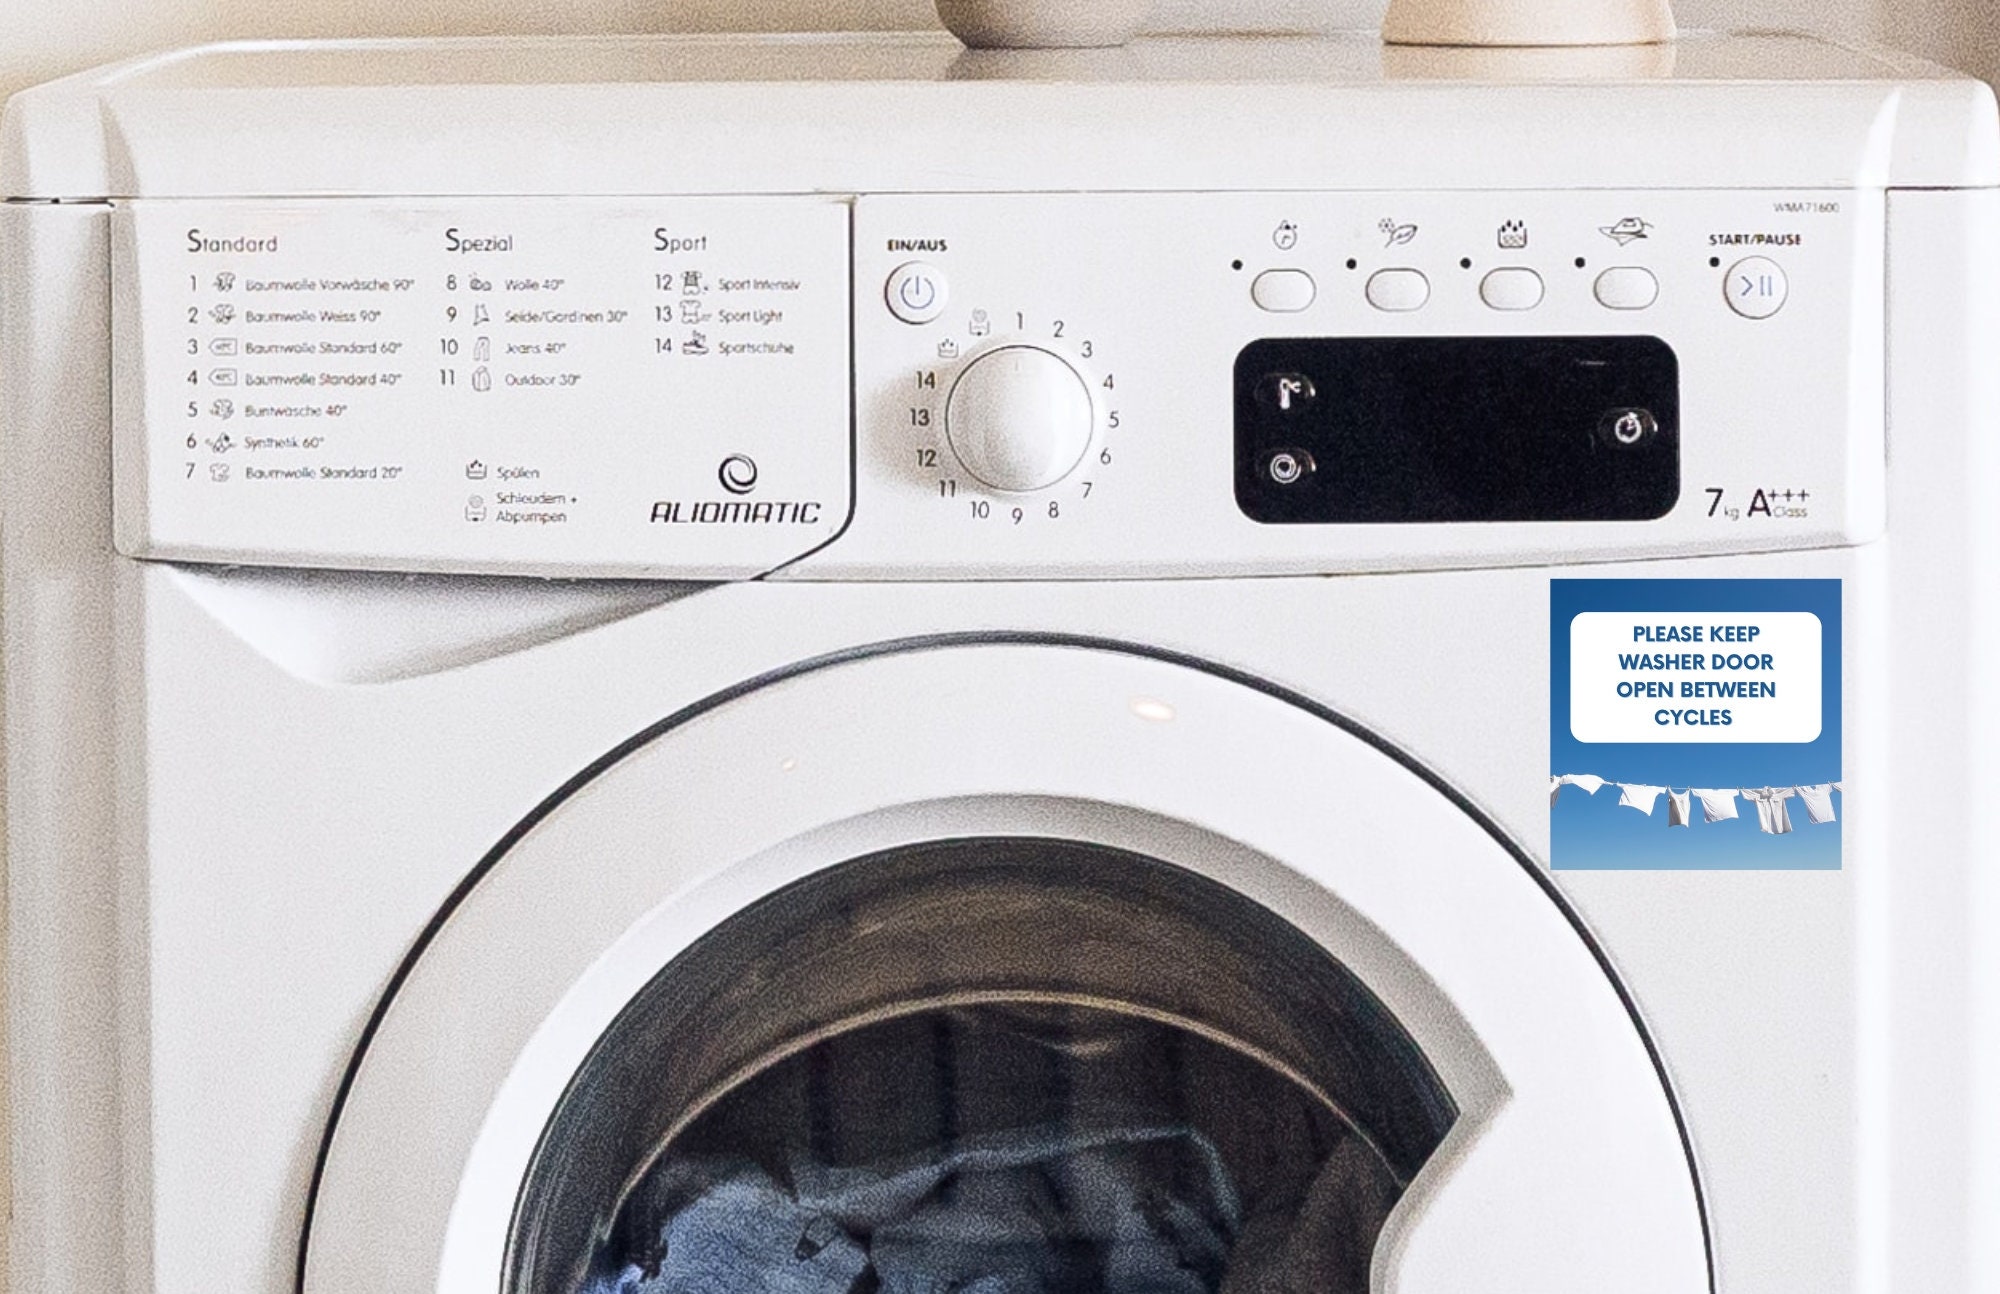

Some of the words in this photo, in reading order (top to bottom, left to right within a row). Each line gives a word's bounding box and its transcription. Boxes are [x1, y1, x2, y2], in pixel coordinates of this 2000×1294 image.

[1774, 203, 1839, 212] WMA71600
[187, 229, 277, 252] Standard
[446, 228, 512, 254] Spezial
[654, 228, 707, 254] Sport
[887, 239, 948, 251] EIN/AUS
[1709, 234, 1801, 245] START/PAUSE
[191, 275, 196, 291] 1
[447, 275, 456, 290] 8
[506, 279, 539, 290] Wolle
[656, 274, 672, 291] 12
[719, 279, 750, 292] Sport
[188, 307, 198, 323] 2
[447, 306, 457, 323] 9
[656, 306, 672, 322] 13
[719, 310, 750, 323] Sport
[754, 310, 782, 325] Light
[1017, 312, 1022, 330] 1
[1054, 321, 1064, 337] 2
[187, 339, 197, 355] 3
[320, 342, 377, 353] Standard
[441, 339, 458, 355] 10
[656, 338, 672, 353] 14
[1082, 341, 1092, 357] 3
[187, 370, 197, 385] 4
[320, 374, 377, 385] Standard
[441, 370, 455, 386] 11
[506, 375, 555, 386] Outdoor
[917, 371, 935, 389] 14
[1104, 374, 1114, 390] 4
[188, 401, 197, 417] 5
[911, 408, 930, 426] 13
[1109, 412, 1119, 428] 5
[187, 433, 196, 449] 6
[245, 437, 299, 450] Synthetik
[917, 449, 936, 467] 12
[1101, 448, 1111, 464] 6
[186, 463, 195, 479] 7
[320, 468, 377, 479] Standard
[940, 480, 956, 497] 11
[1082, 482, 1093, 499] 7
[972, 501, 989, 519] 10
[1049, 502, 1059, 518] 8
[1705, 488, 1723, 517] 7
[496, 509, 567, 524] Abpumpen
[650, 502, 821, 524] ALIOMATIC
[1012, 508, 1023, 525] 9
[1633, 626, 1704, 643] PLEASE
[1710, 626, 1760, 642] KEEP
[1618, 654, 1706, 670] WASHER
[1712, 654, 1774, 670] DOOR
[1616, 682, 1674, 698] OPEN
[1681, 682, 1776, 698] BETWEEN
[1654, 709, 1732, 726] CYCLES
